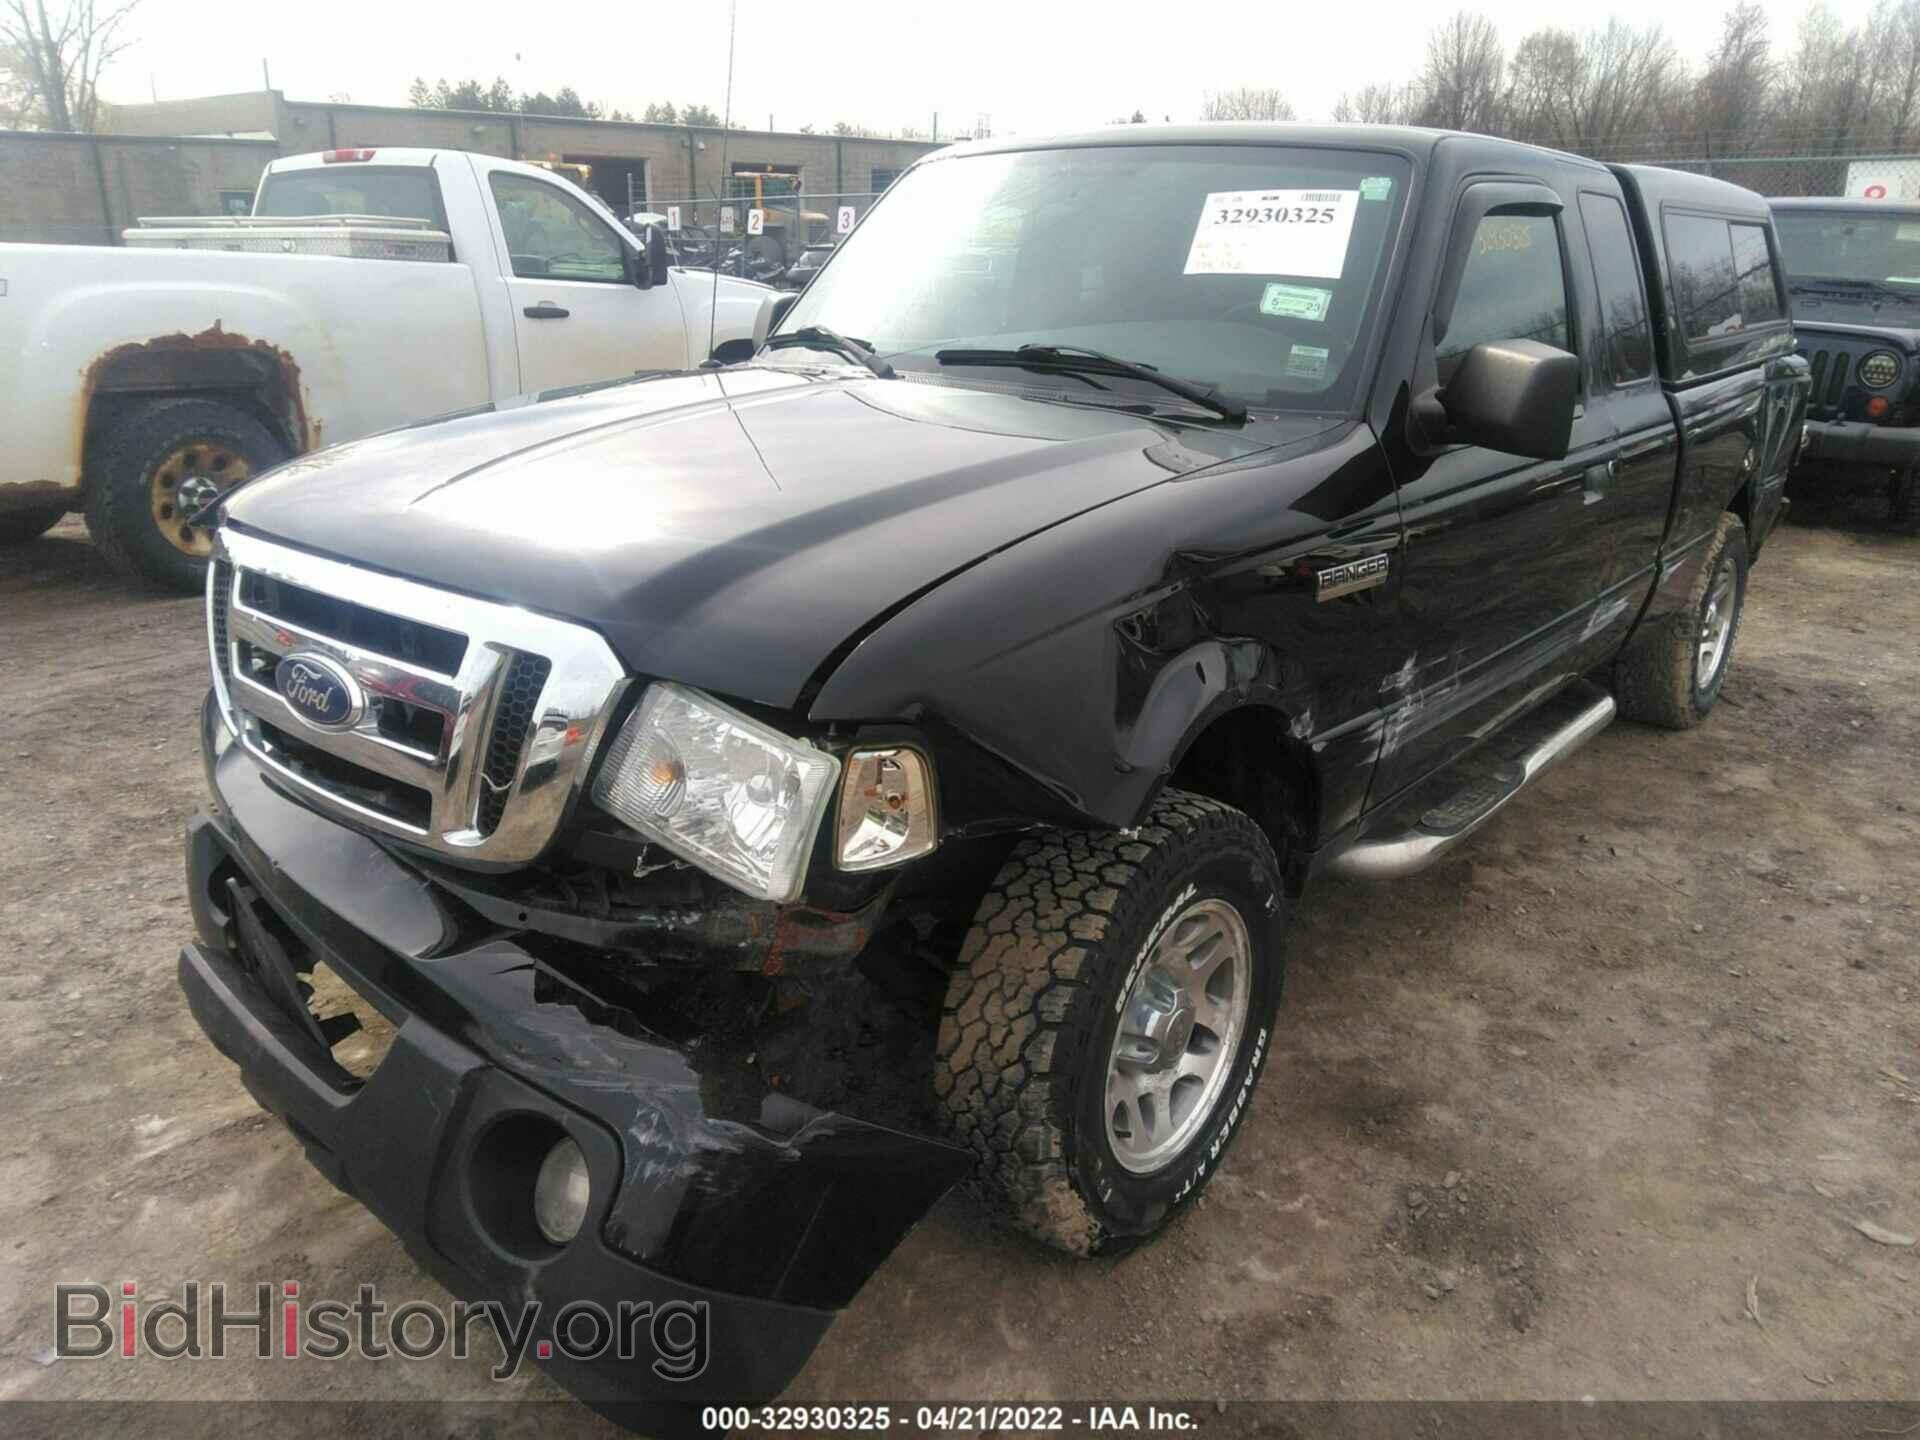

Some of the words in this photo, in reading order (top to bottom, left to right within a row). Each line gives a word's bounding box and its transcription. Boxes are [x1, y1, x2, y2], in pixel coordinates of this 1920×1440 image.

[751, 214, 760, 230] 2
[842, 211, 850, 229] 3
[1214, 207, 1335, 224] 32930325
[286, 663, 335, 712] Ford
[1209, 1028, 1267, 1160] GRABBER
